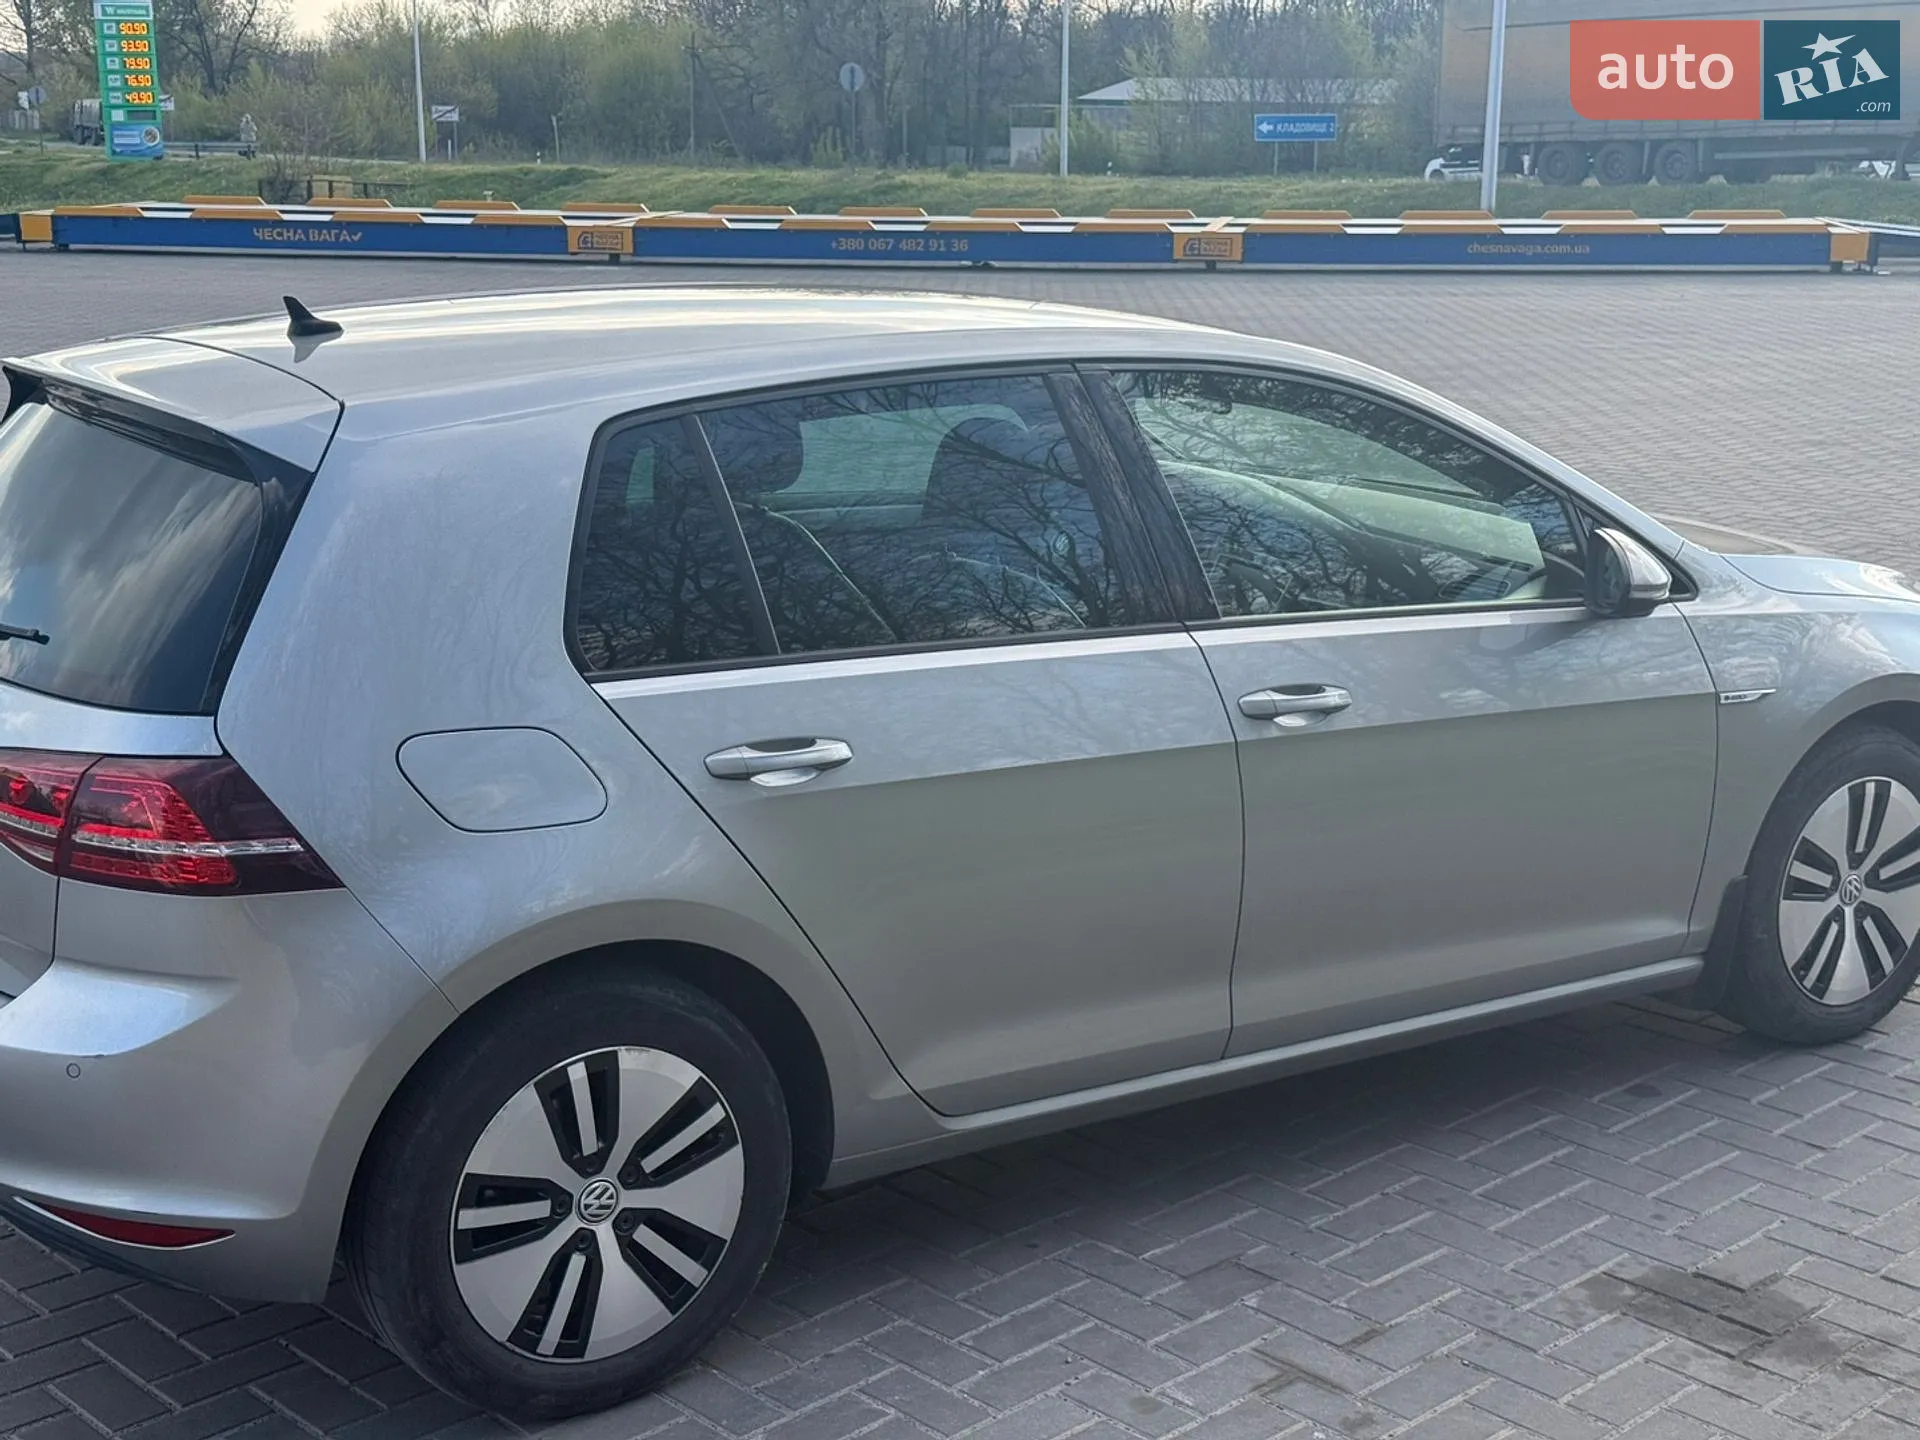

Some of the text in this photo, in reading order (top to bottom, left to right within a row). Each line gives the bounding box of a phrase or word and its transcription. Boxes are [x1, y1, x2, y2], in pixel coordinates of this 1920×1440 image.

[253, 227, 352, 243] ЧЕСНА ВАГА
[831, 238, 969, 252] +380 067 482 91 36
[1467, 241, 1590, 255] chesnavaga.com.ua
